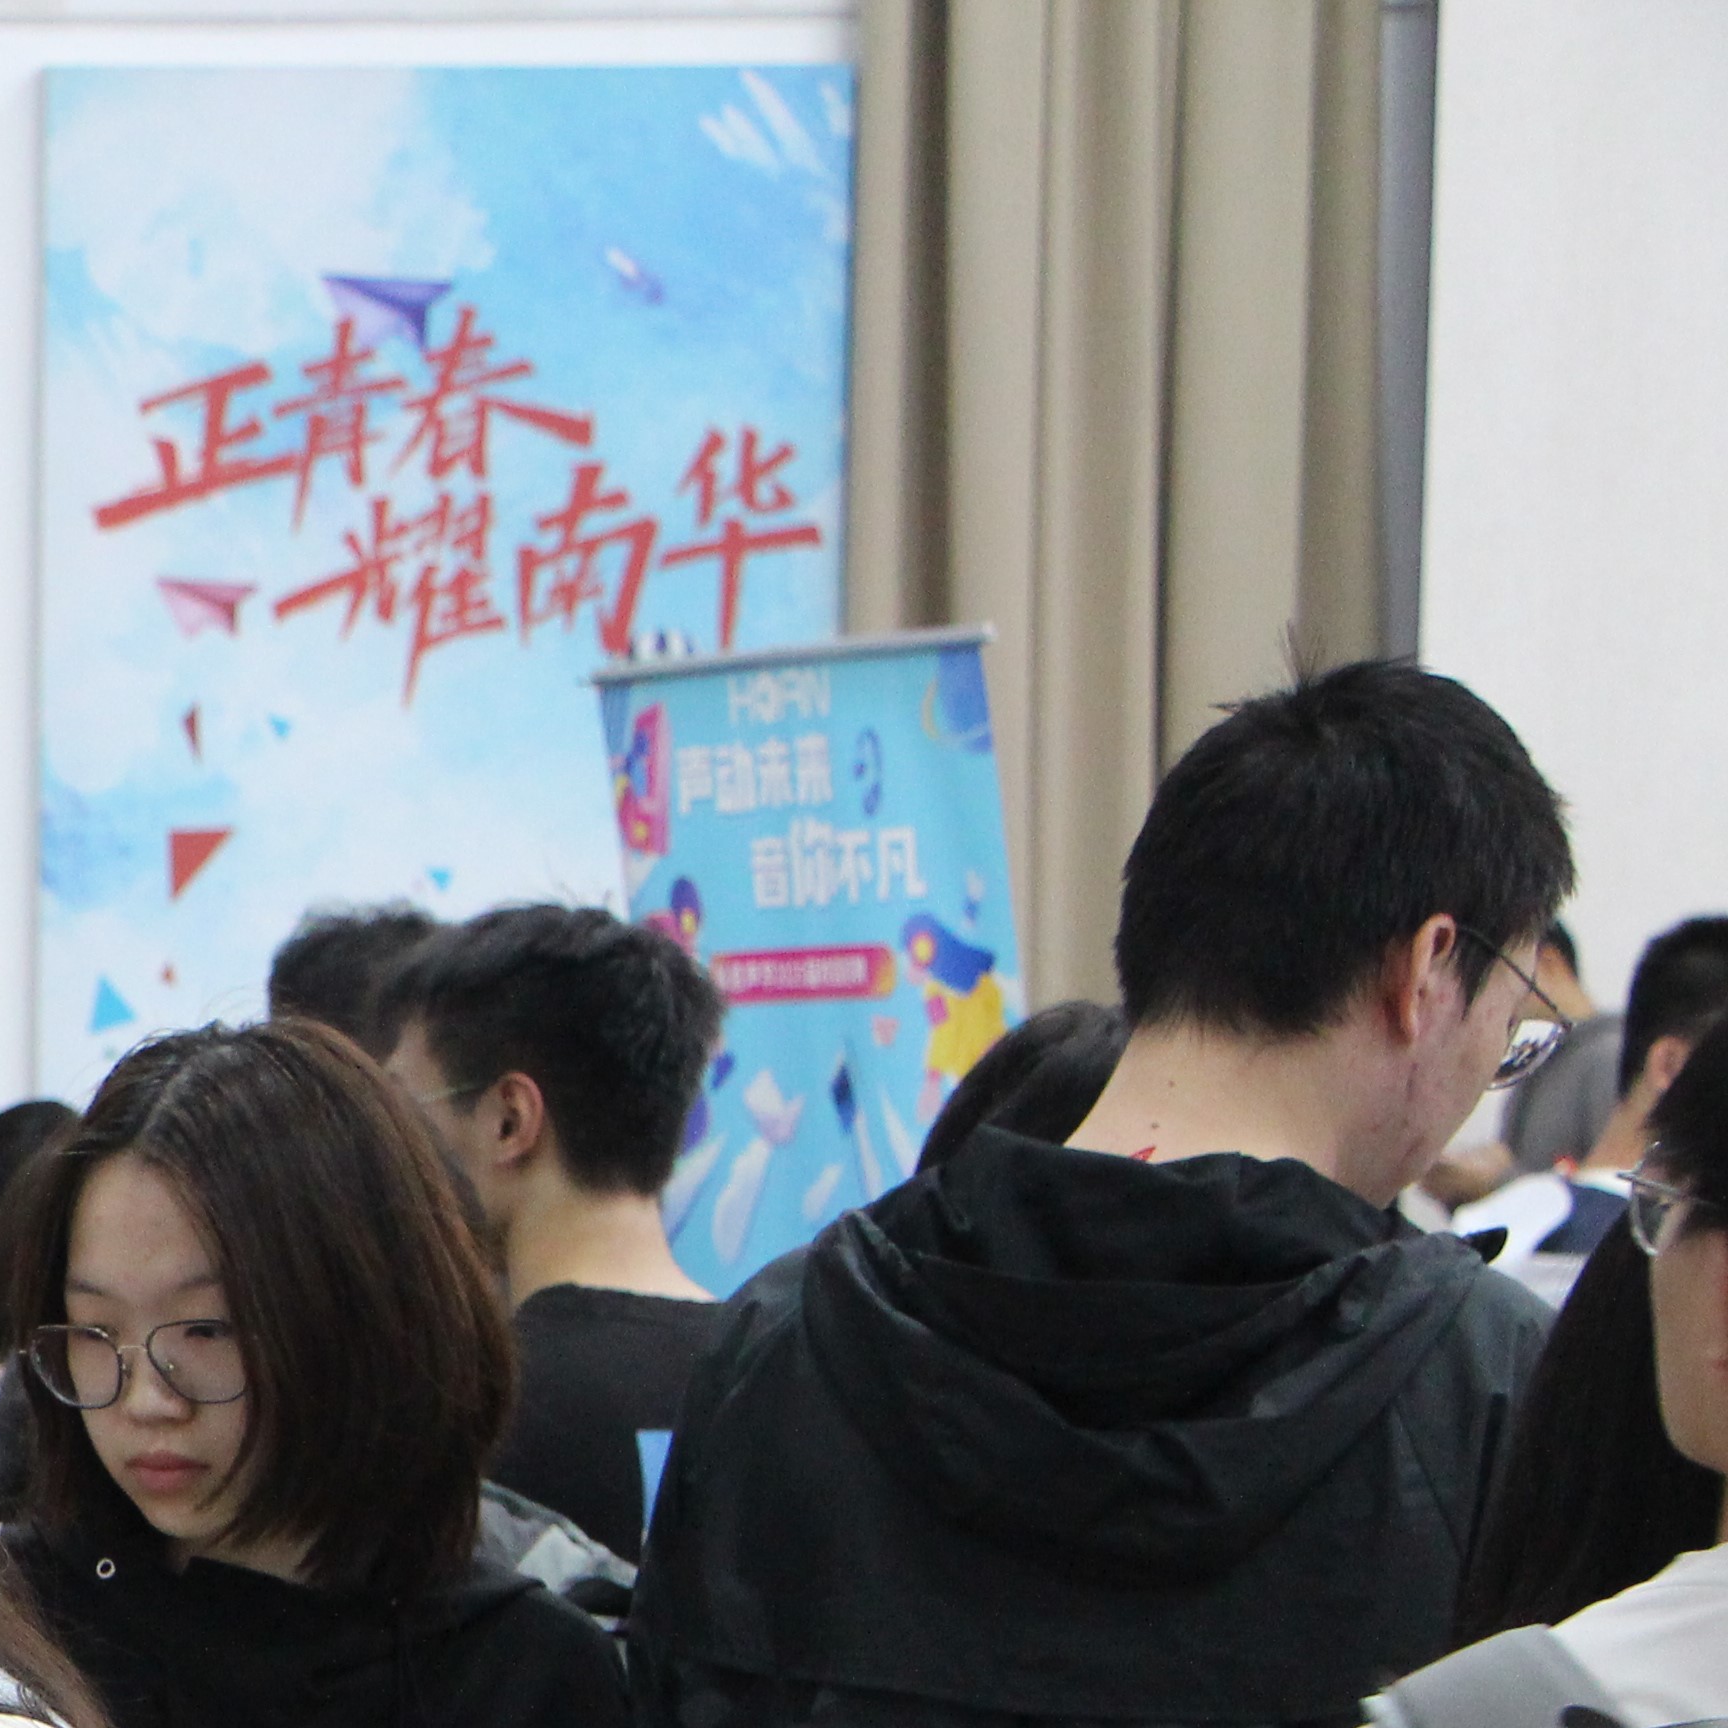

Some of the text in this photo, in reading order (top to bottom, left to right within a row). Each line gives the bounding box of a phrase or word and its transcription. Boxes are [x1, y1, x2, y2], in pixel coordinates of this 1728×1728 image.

[90, 305, 593, 530] 正青春
[273, 425, 821, 709] 耀南华
[678, 733, 833, 816] 声动未来
[751, 815, 928, 908] 音你不凡
